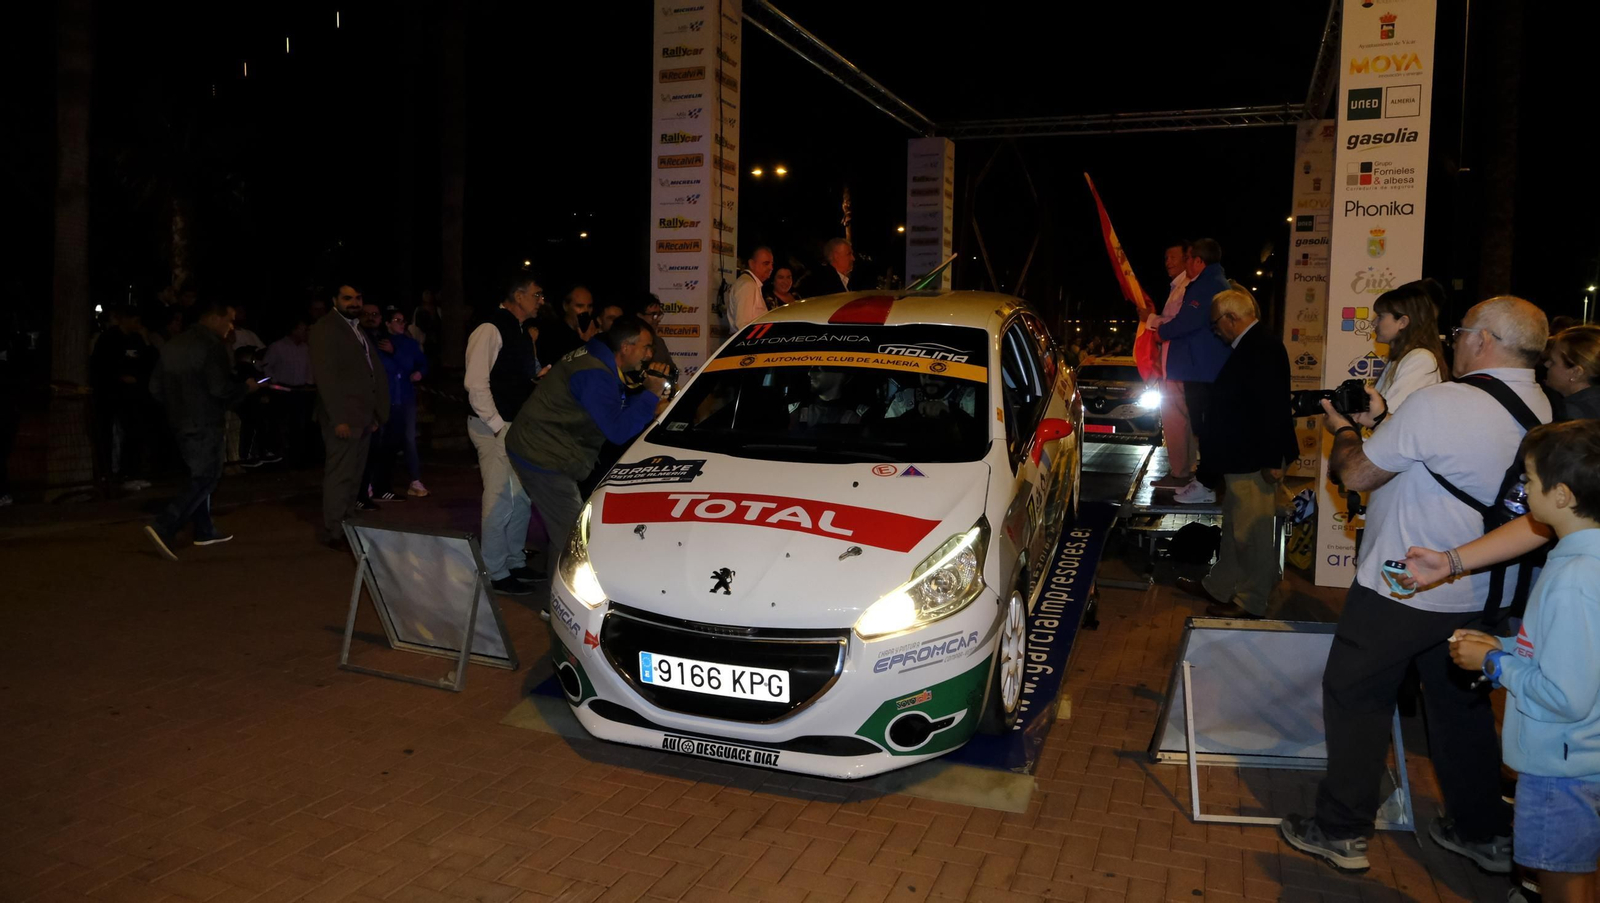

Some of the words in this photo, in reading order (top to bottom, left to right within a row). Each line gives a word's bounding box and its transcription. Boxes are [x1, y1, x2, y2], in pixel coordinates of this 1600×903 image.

[662, 46, 704, 57] Rallycar
[1349, 52, 1423, 75] MOYA
[1350, 98, 1379, 110] UNED
[661, 132, 703, 143] Rallycar
[1346, 127, 1419, 150] gasolia
[666, 156, 695, 166] Recalvi
[1374, 167, 1415, 176] Fornieles
[1373, 177, 1381, 185] &
[1383, 176, 1415, 185] albesa
[1344, 200, 1415, 217] Phonika
[659, 217, 700, 229] Rallycar
[665, 241, 694, 251] Recalvi
[659, 302, 700, 314] Rallycar
[663, 326, 693, 335] Recalvi
[735, 333, 871, 347] AUTOMECÁNICA
[884, 346, 969, 363] MOLINA
[763, 355, 823, 363] AUTOMÓVIL
[872, 359, 920, 368] ALMERÍA
[629, 464, 694, 474] RALLYE
[667, 493, 854, 536] TOTAL
[873, 630, 979, 674] EPROMCAR
[657, 659, 722, 690] 9166
[732, 669, 783, 698] KPG
[696, 742, 752, 763] DESGUACE
[753, 751, 781, 767] DIAZ
